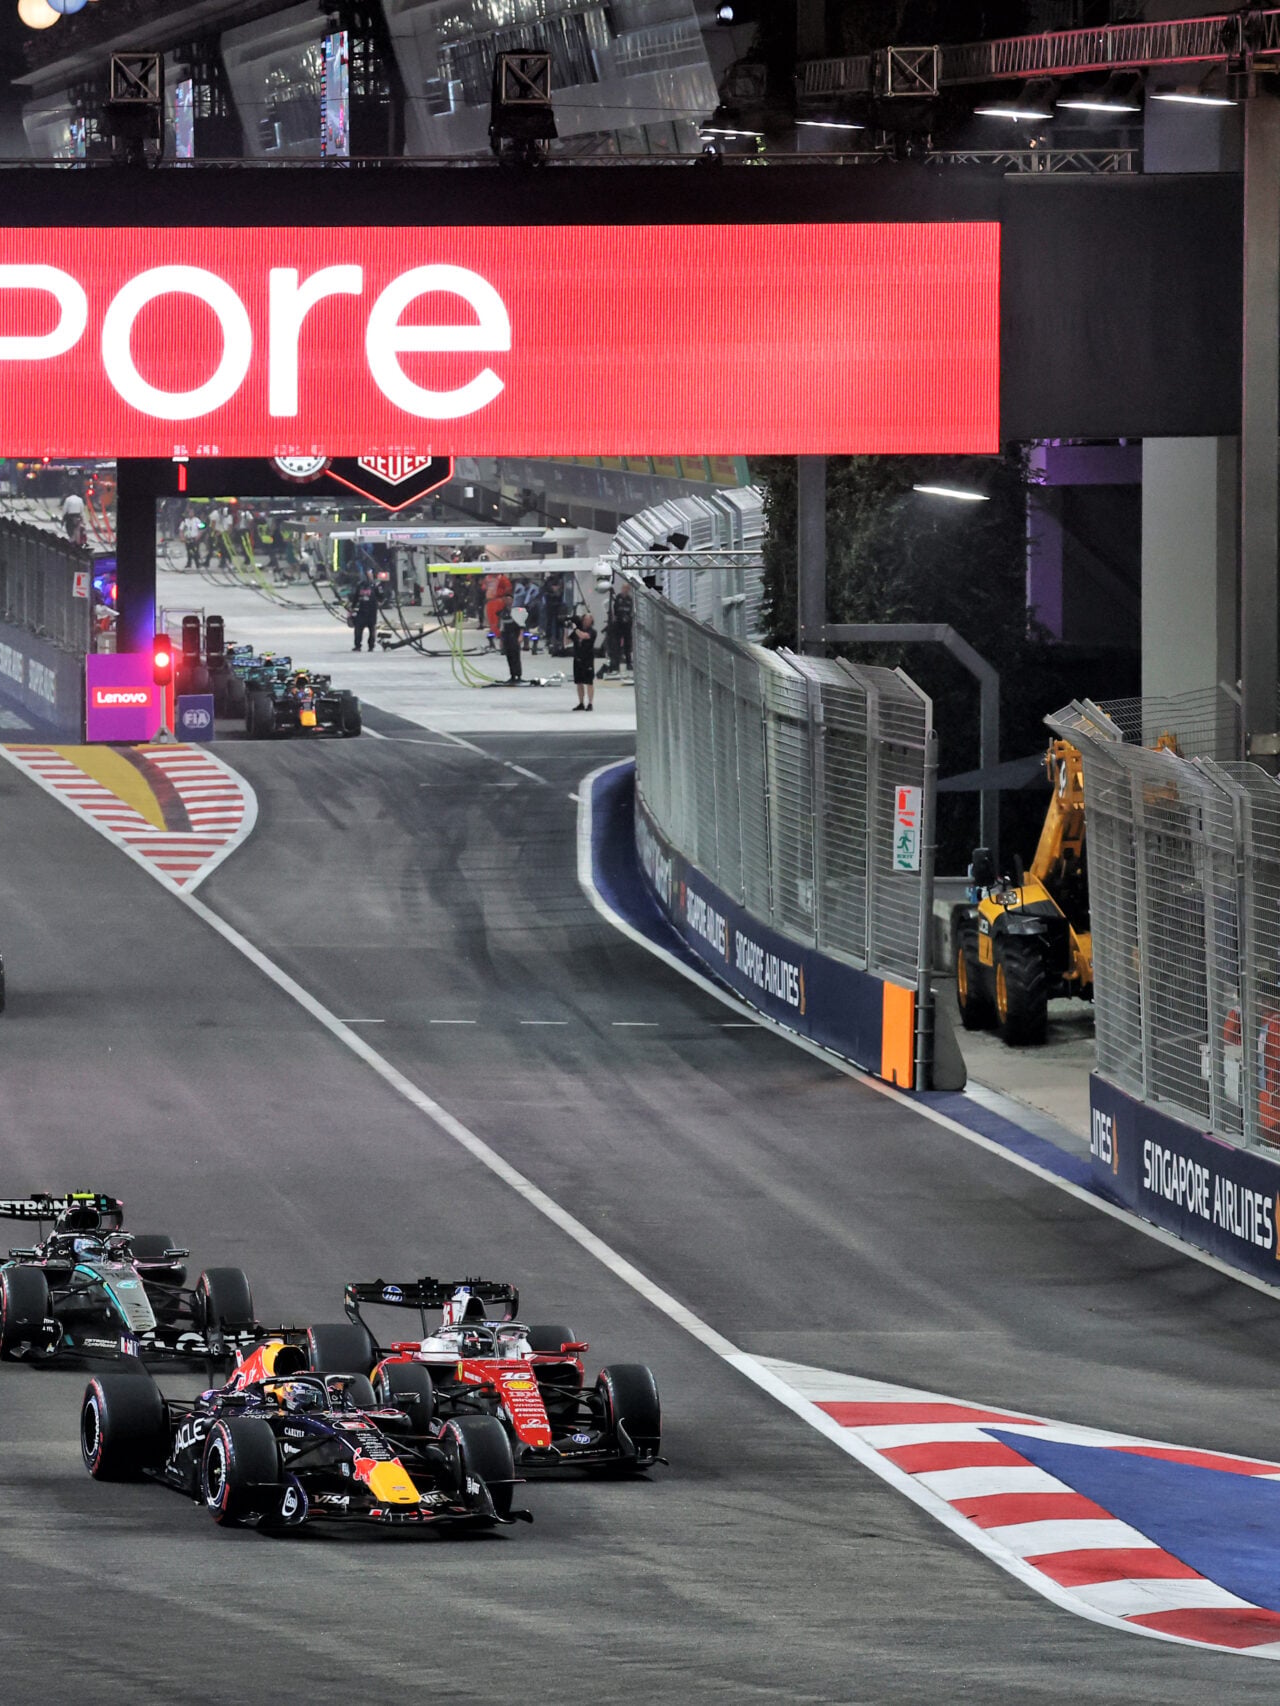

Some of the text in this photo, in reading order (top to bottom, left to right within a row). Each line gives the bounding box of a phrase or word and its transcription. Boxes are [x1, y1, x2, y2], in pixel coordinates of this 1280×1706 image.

[97, 691, 147, 704] Lenovo
[184, 709, 211, 726] FIA
[735, 930, 799, 1007] SINGAPORE AIRLINES
[1143, 1138, 1211, 1221] SINGAPORE
[1213, 1174, 1273, 1250] AIRLINES
[500, 1372, 531, 1380] 16
[312, 1494, 350, 1505] VISA
